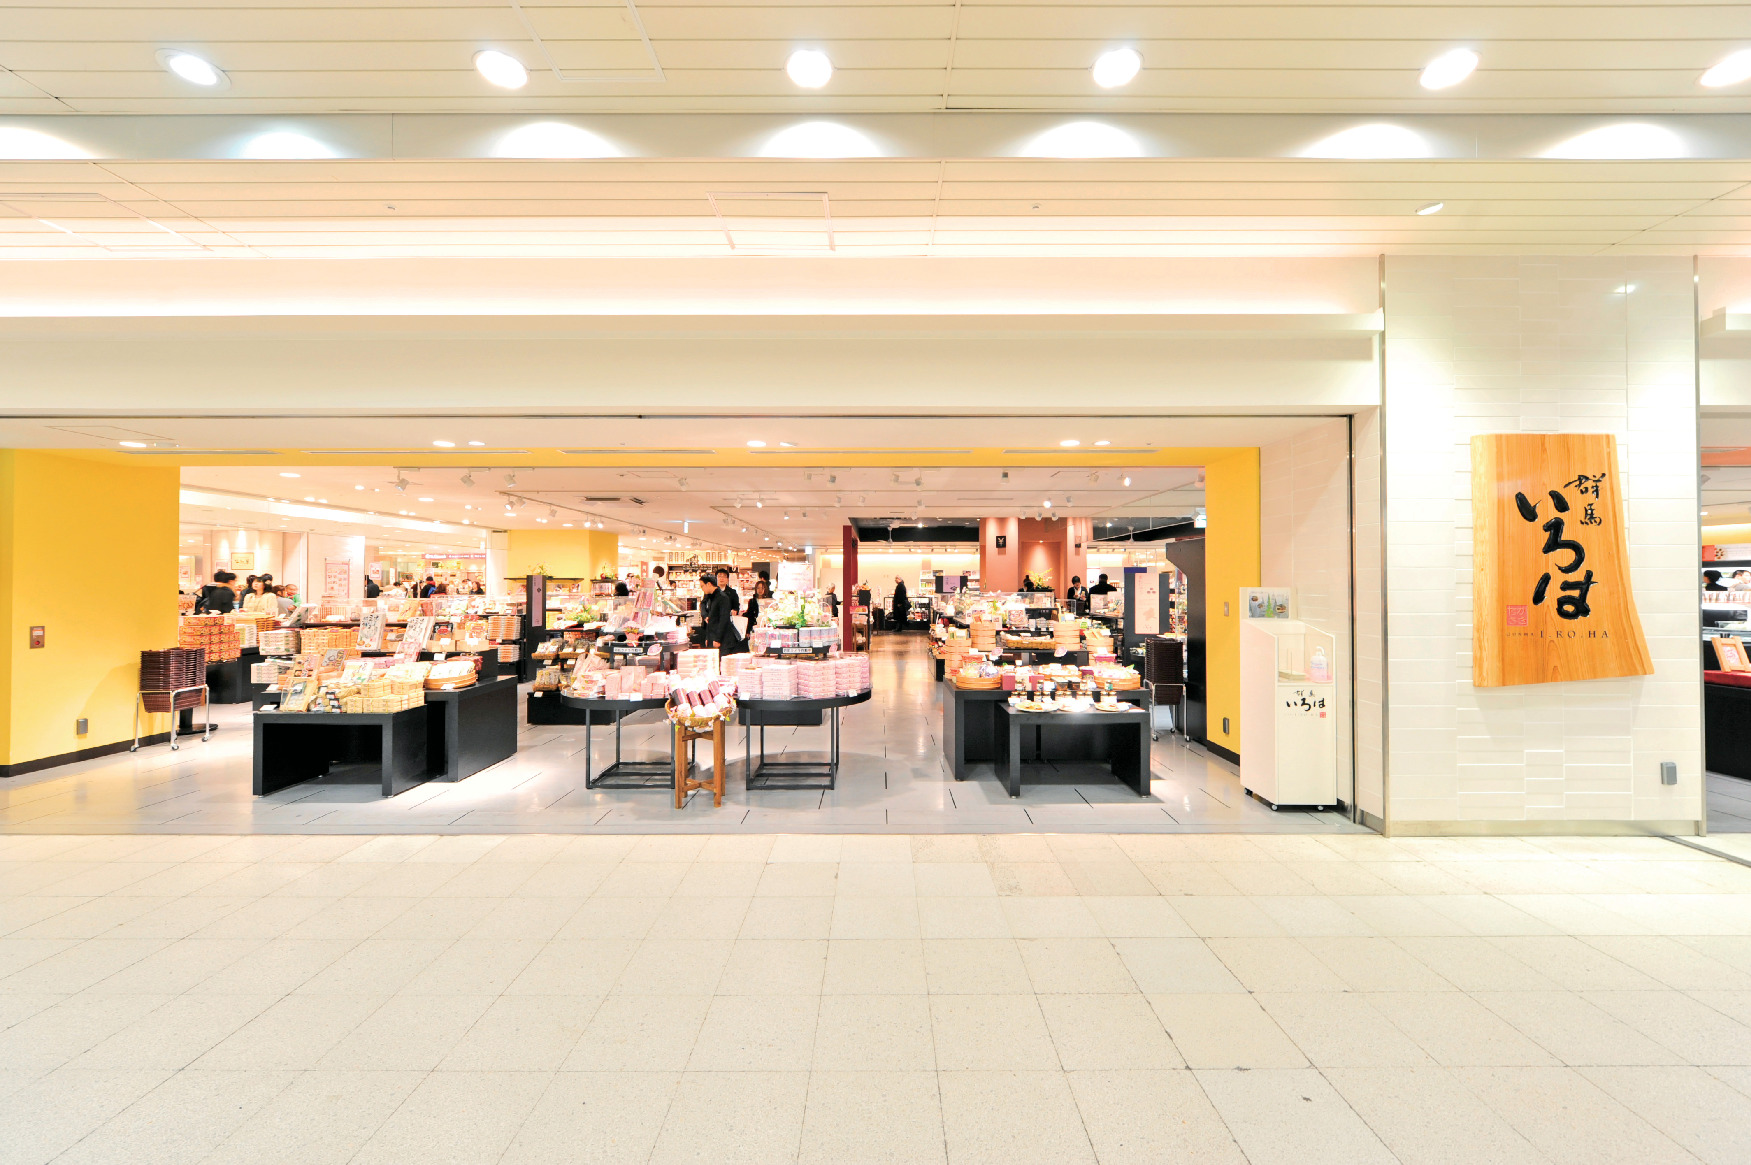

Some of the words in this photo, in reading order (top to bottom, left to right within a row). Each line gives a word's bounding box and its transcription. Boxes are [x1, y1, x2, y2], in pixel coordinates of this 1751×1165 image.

[1563, 473, 1606, 526] 群馬
[1515, 490, 1599, 620] いろは
[1286, 697, 1326, 712] いろは
